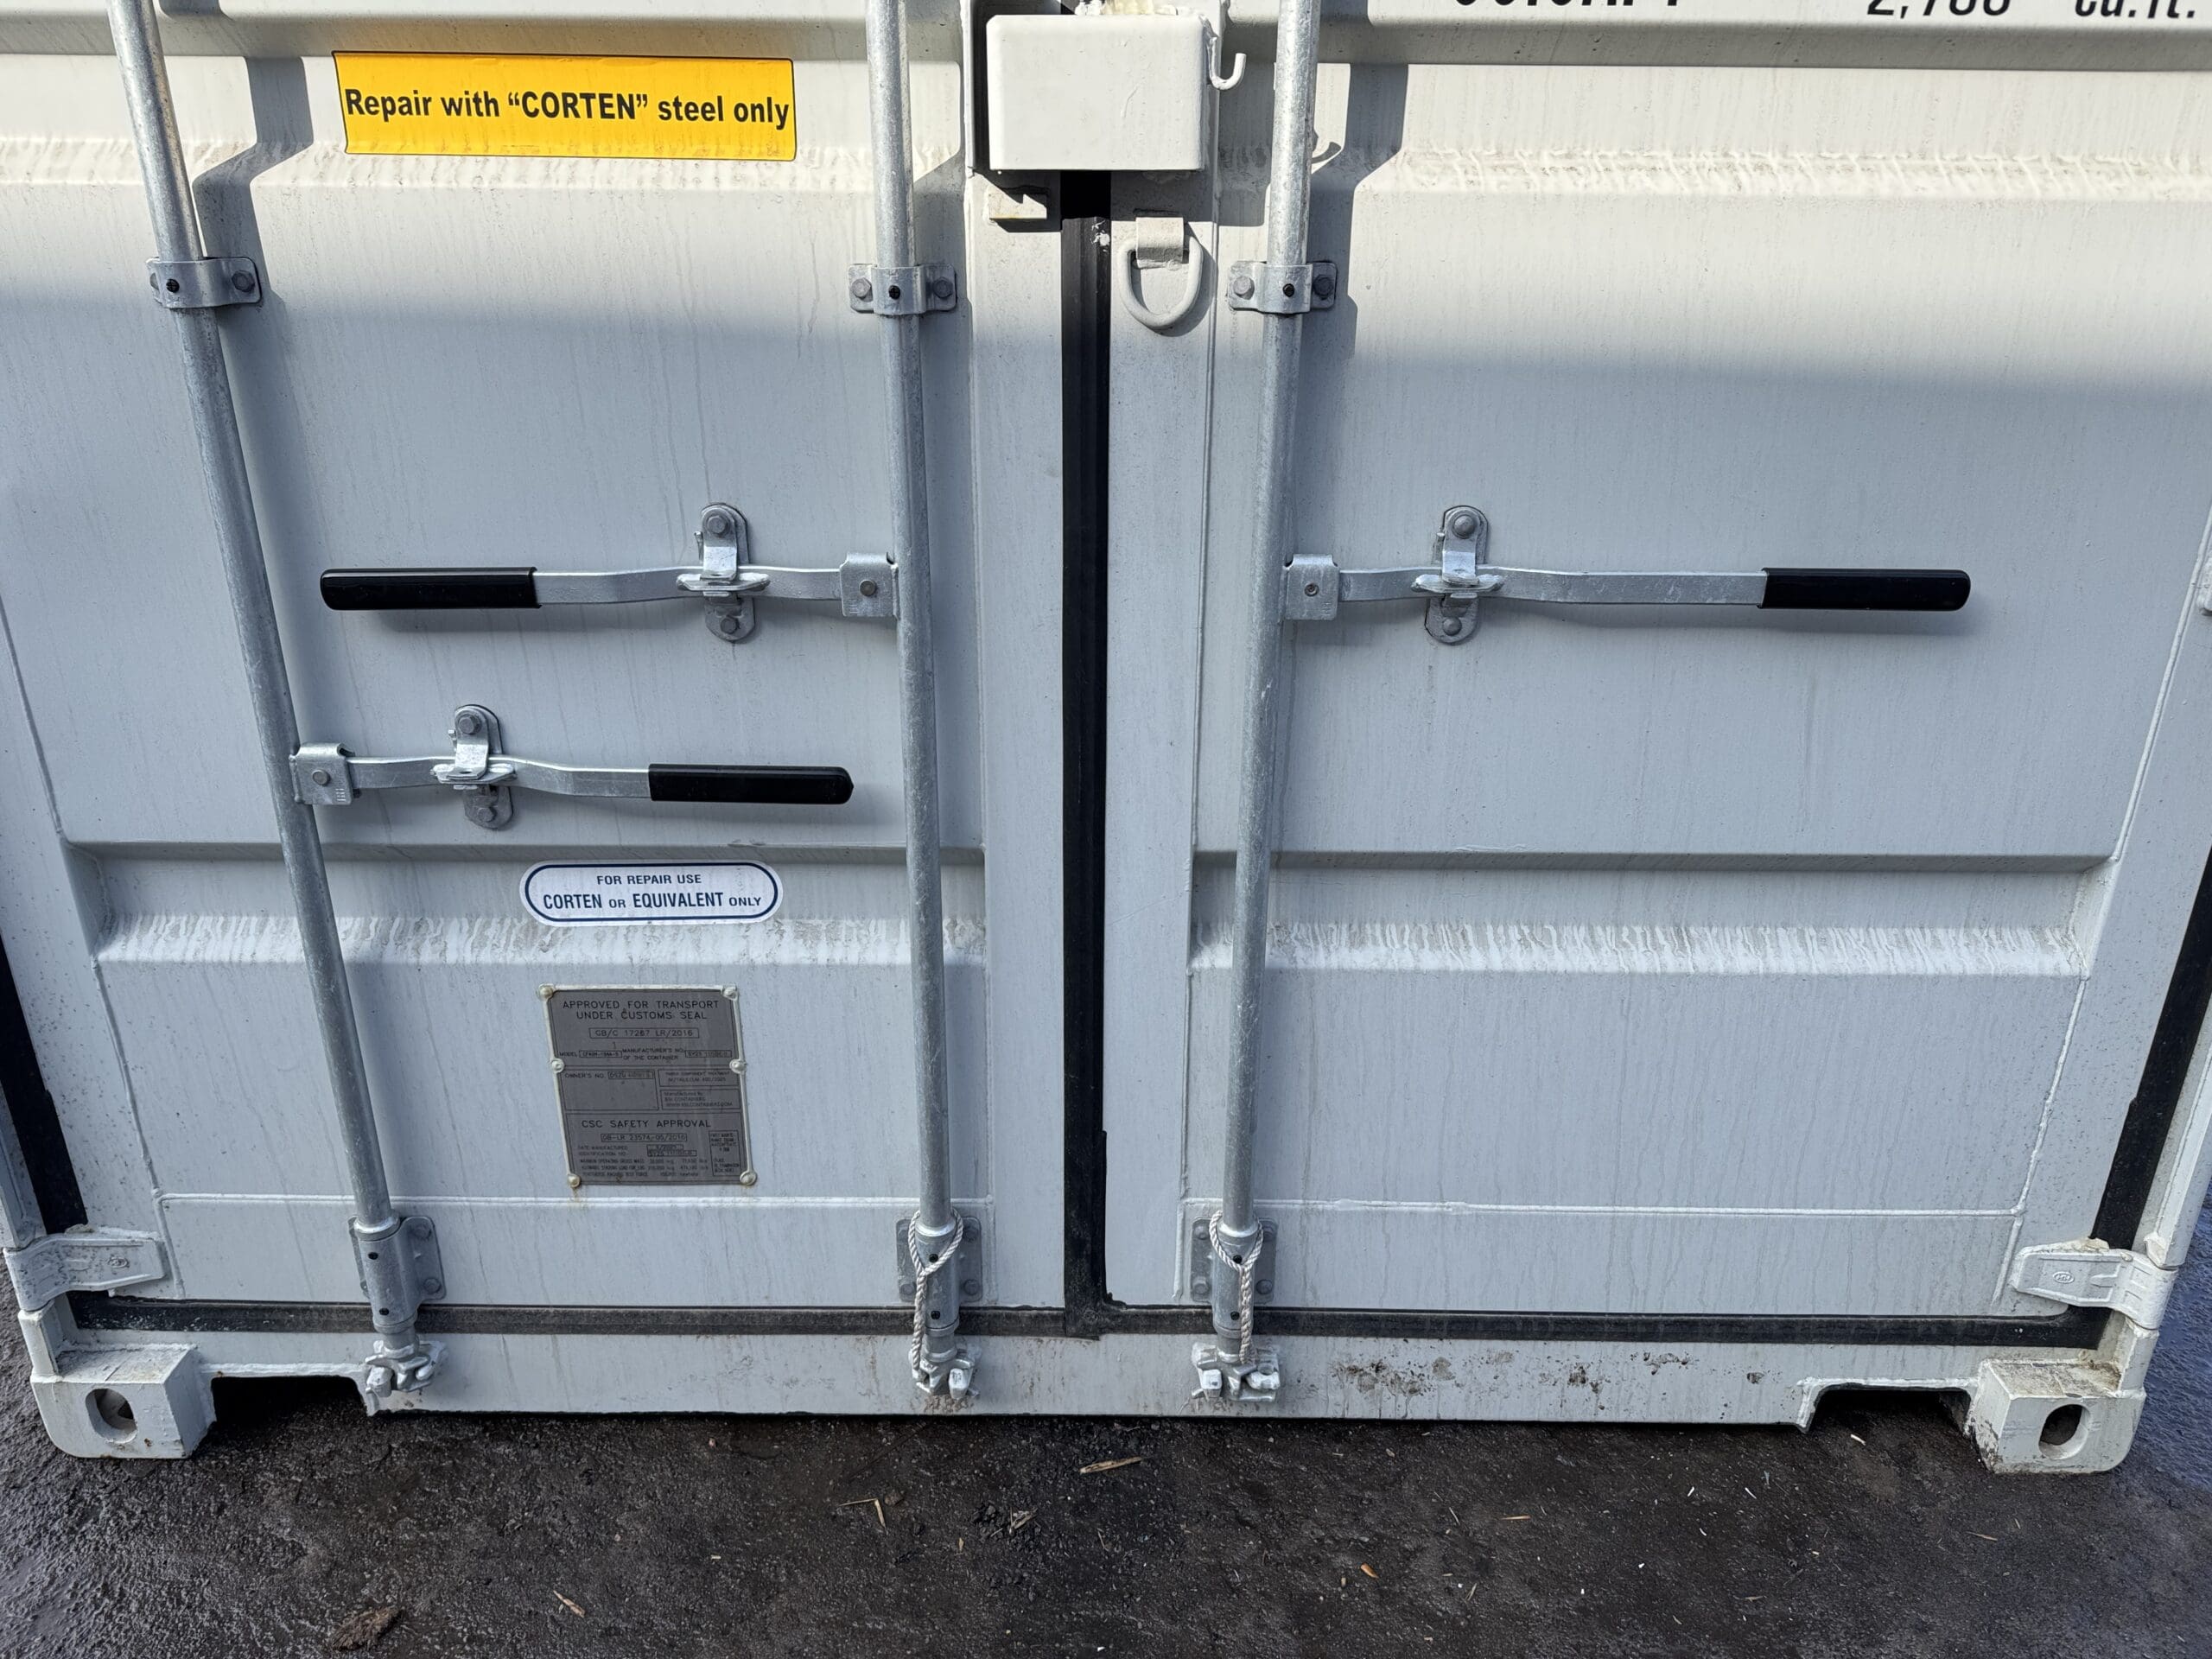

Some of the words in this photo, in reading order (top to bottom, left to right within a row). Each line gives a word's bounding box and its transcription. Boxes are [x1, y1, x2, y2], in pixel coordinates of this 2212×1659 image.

[345, 88, 432, 123] Repair
[441, 90, 499, 118] with
[658, 95, 724, 123] steel
[734, 96, 790, 130] only
[596, 875, 622, 886] FOR
[627, 874, 672, 885] REPAIR
[677, 874, 702, 884] USE
[543, 893, 603, 909] CORTEN
[608, 899, 626, 909] OR
[632, 892, 724, 908] EQUIVALENT
[728, 897, 762, 907] ONLY
[563, 1000, 620, 1010] APPROVED
[627, 1000, 649, 1009] FOR
[656, 1000, 720, 1009] TRANSPORT
[576, 1011, 613, 1020] UNDER
[620, 1010, 673, 1020] CUSTOMS
[679, 1011, 708, 1020] SEAL
[594, 1029, 619, 1038] GB/C
[655, 1029, 694, 1038] LR/2016
[582, 1120, 603, 1128] CSC
[656, 1119, 712, 1128] APPROVAL
